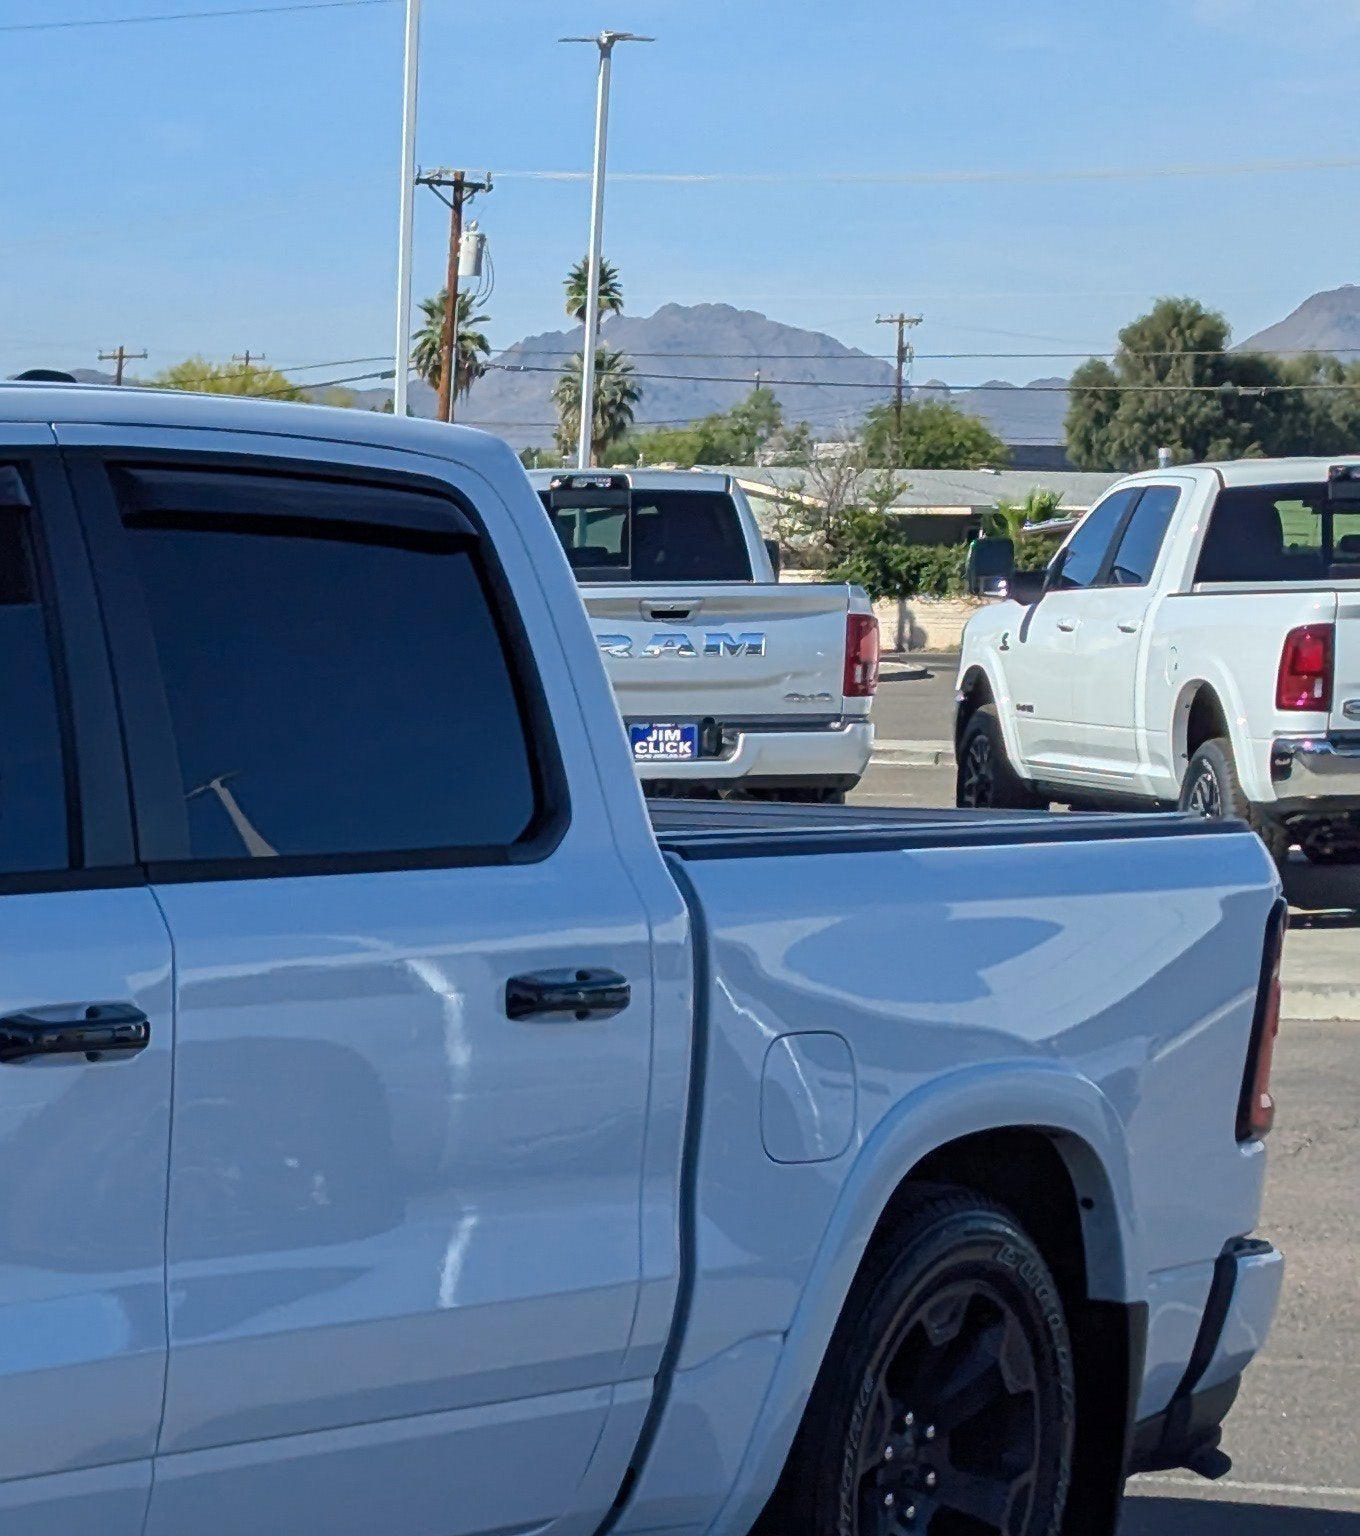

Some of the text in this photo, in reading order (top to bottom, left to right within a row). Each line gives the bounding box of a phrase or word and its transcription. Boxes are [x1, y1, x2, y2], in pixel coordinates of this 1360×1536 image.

[597, 632, 767, 658] RAM
[646, 729, 682, 742] JIM
[634, 741, 692, 754] CLICK
